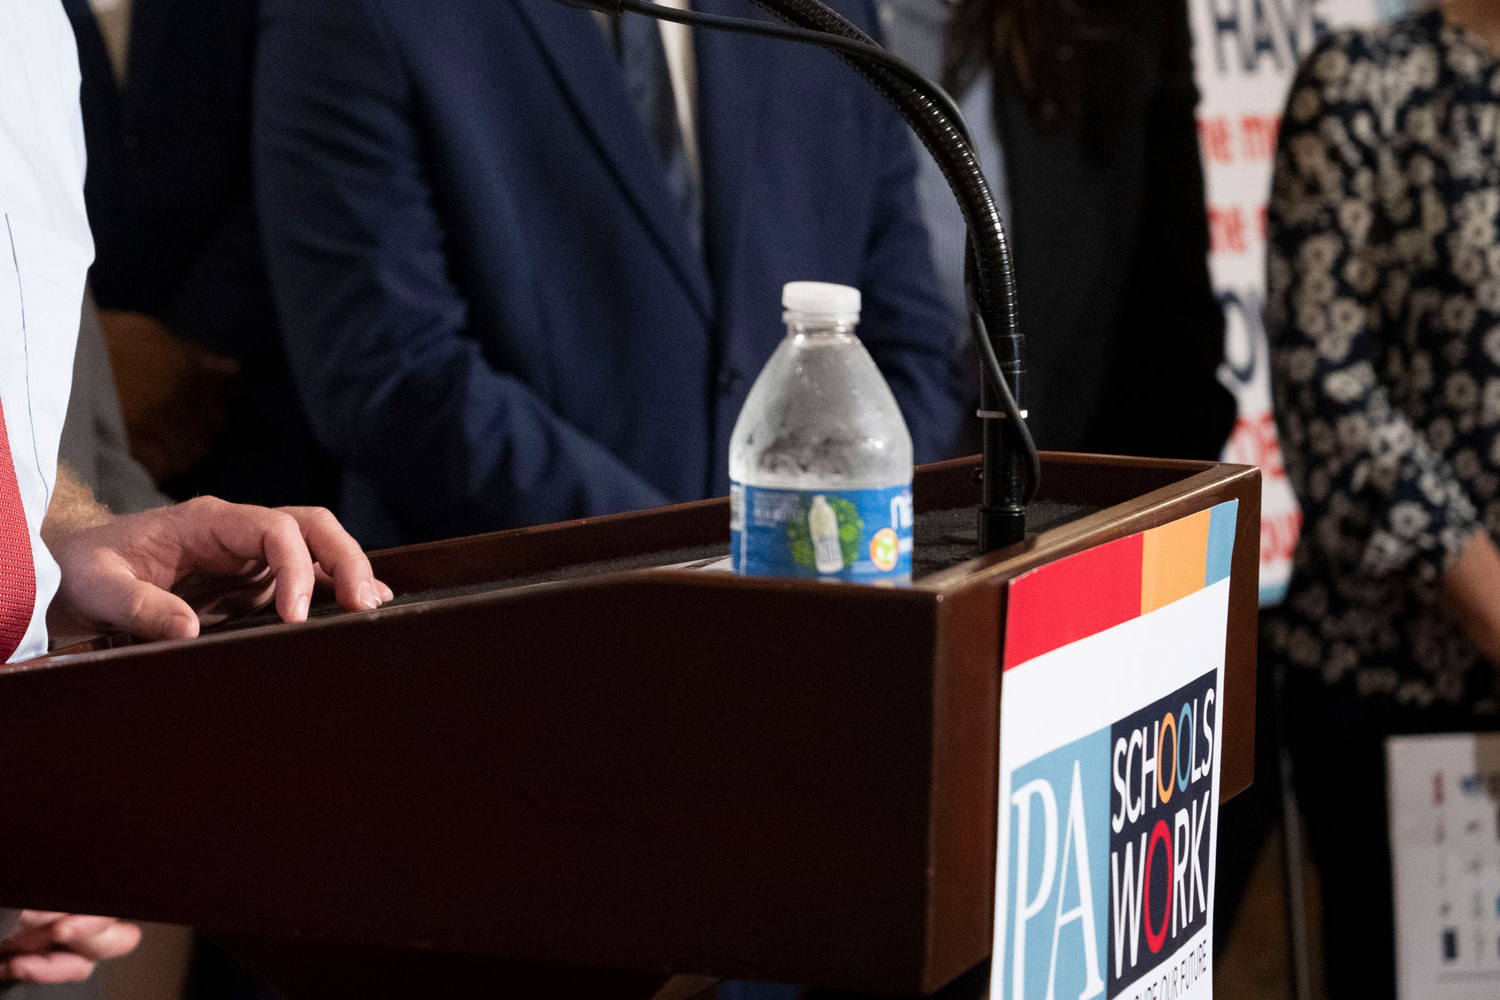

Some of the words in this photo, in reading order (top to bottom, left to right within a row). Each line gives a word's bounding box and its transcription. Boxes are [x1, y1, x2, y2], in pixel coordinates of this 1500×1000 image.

[1111, 687, 1215, 833] SCHOOLS
[1010, 760, 1105, 1000] PA
[1111, 790, 1210, 980] WORK
[1181, 939, 1206, 994] FUTURE
